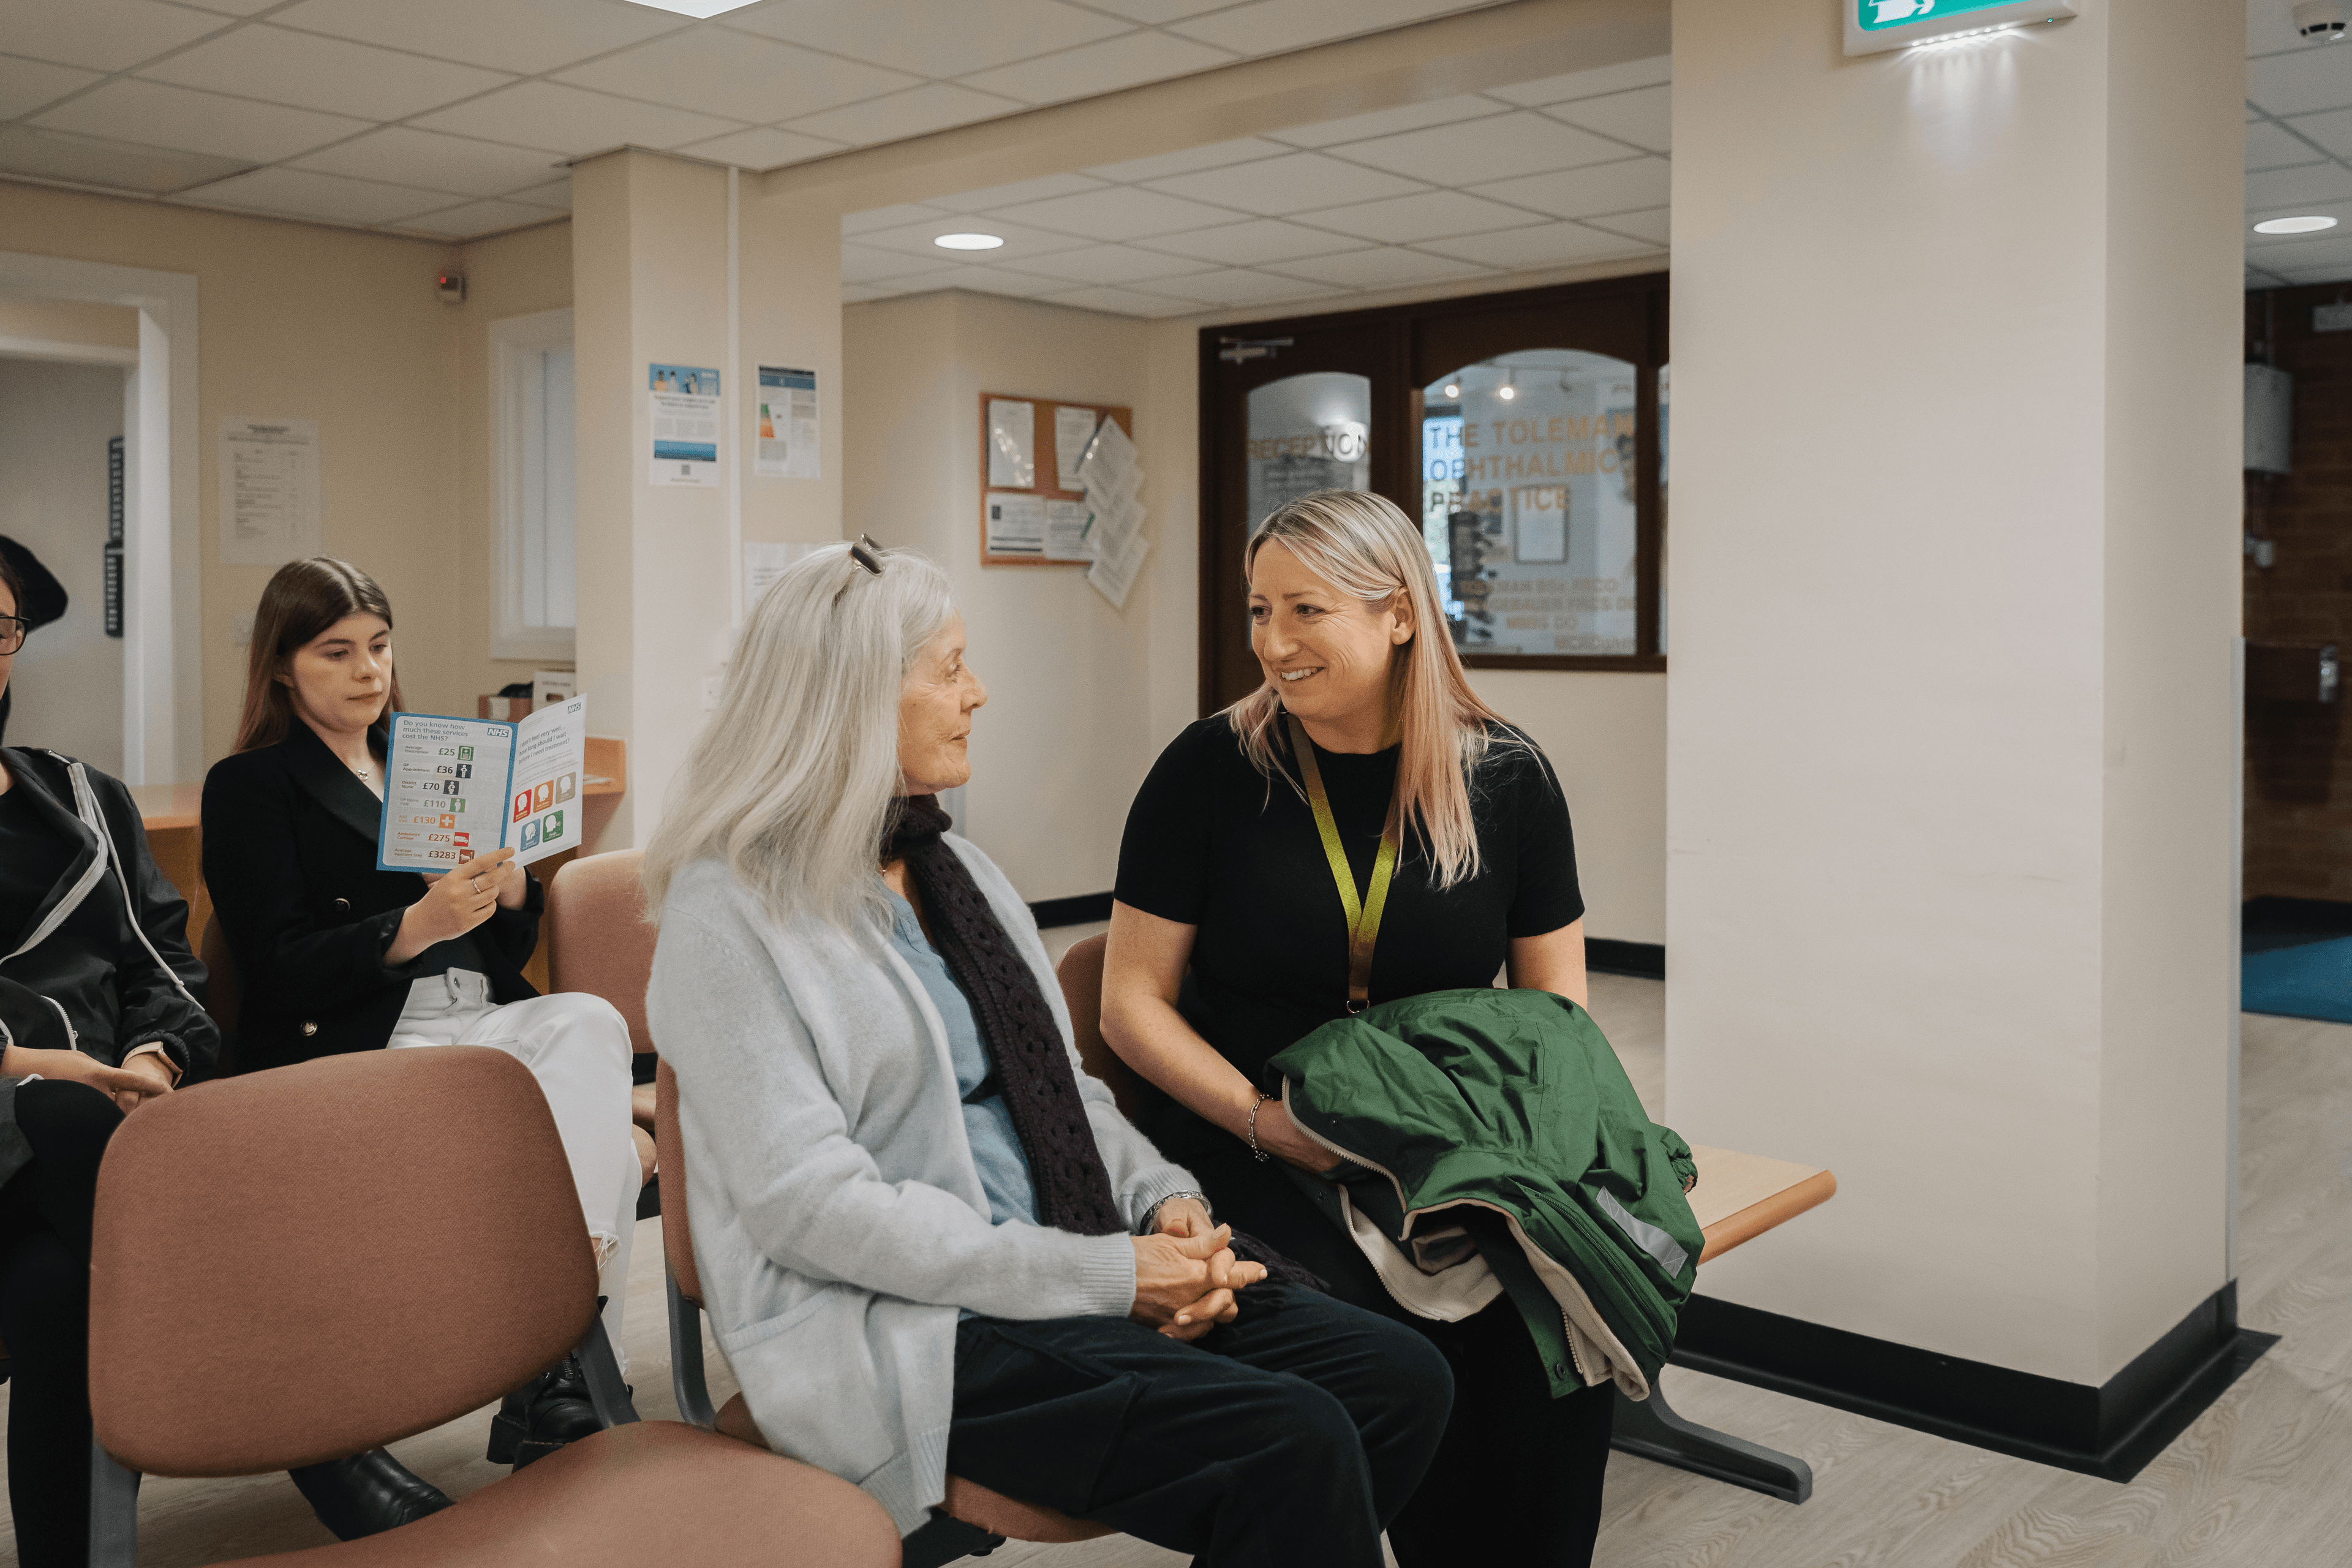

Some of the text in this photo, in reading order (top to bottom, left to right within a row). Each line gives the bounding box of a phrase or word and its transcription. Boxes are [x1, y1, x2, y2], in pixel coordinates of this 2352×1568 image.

[1429, 413, 1634, 448] THE TOLEMAN
[568, 703, 581, 714] NHS
[488, 728, 509, 737] NHS
[537, 736, 552, 747] should
[533, 747, 545, 756] need
[545, 737, 570, 752] treatment?
[438, 747, 456, 756] £25
[424, 799, 446, 808] £110
[428, 834, 450, 842] £275
[428, 851, 456, 859] £3283
